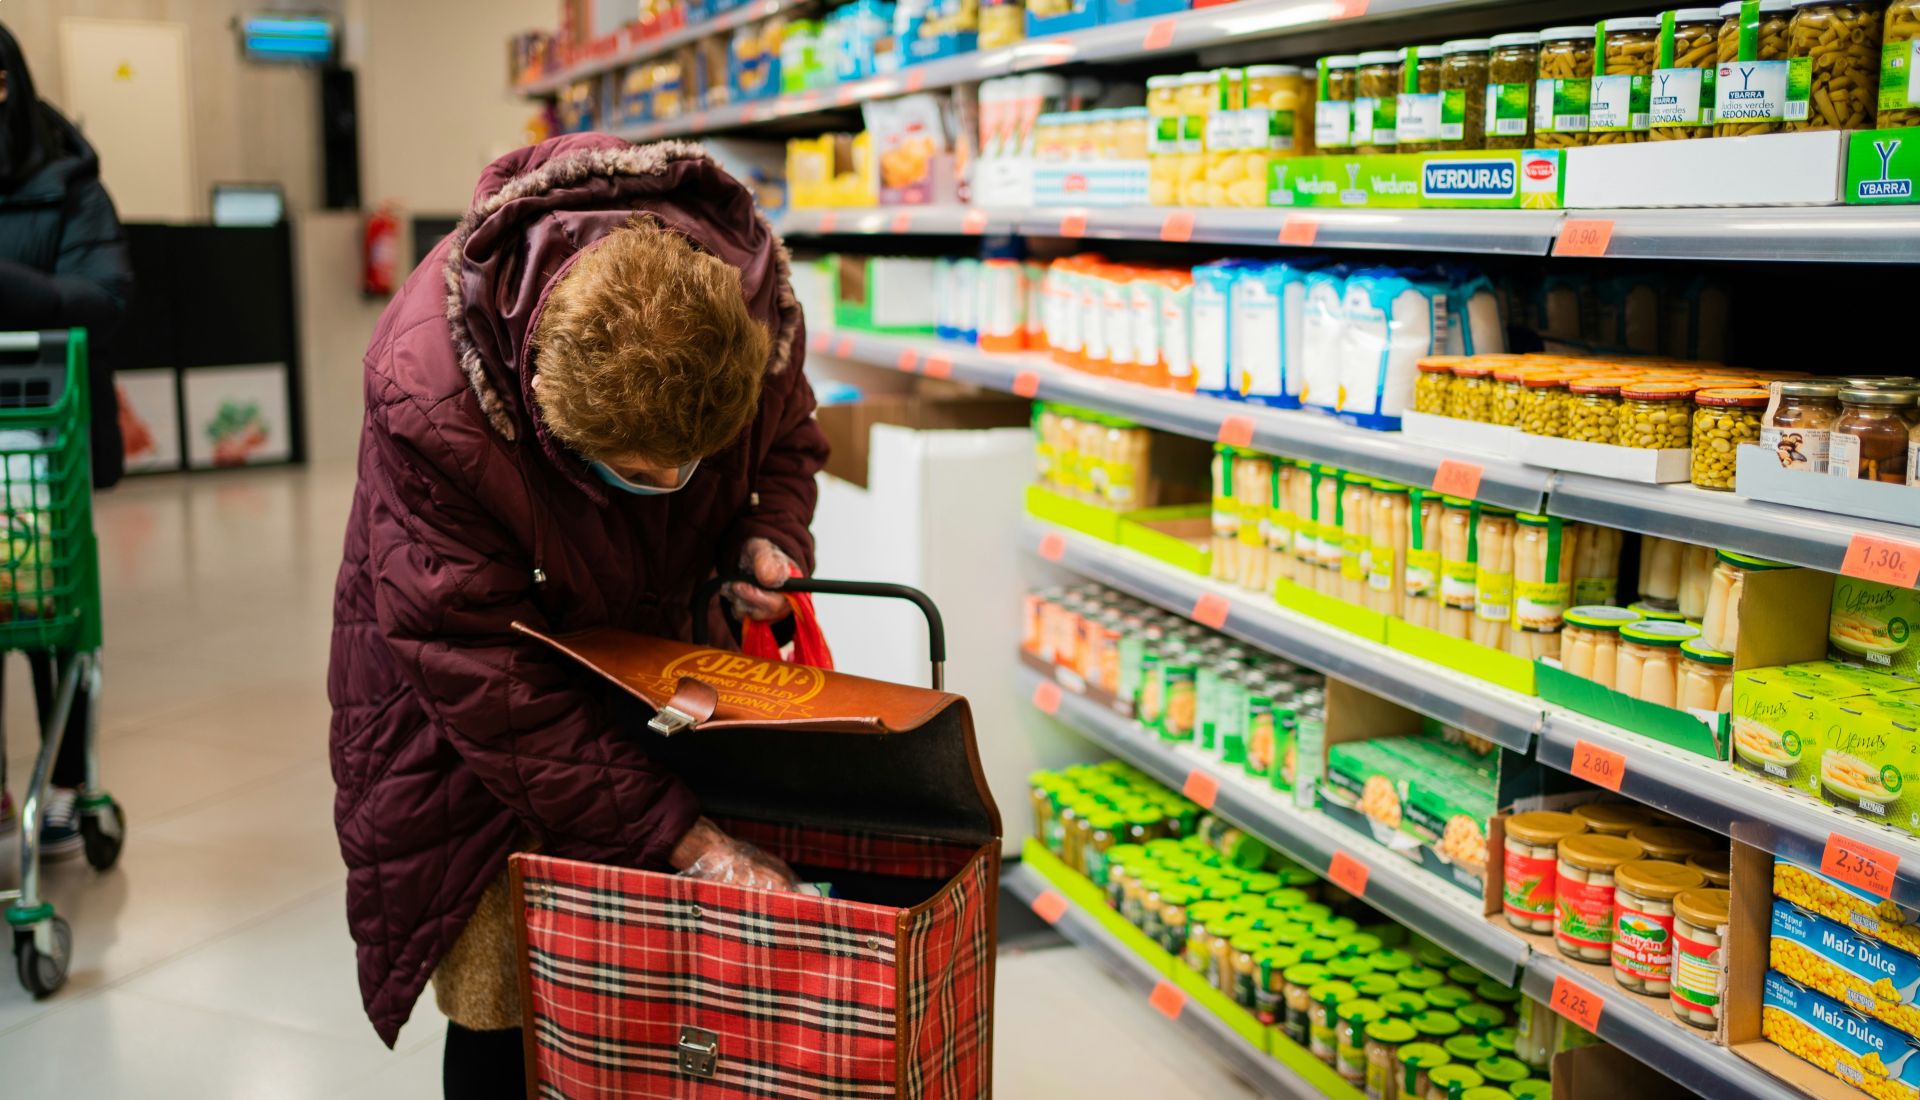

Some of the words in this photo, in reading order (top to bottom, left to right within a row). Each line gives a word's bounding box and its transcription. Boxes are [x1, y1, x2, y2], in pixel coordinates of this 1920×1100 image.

[1744, 99, 1774, 110] verdes
[1295, 173, 1337, 195] Verduras
[1371, 173, 1418, 195] Verduras
[1426, 167, 1513, 191] VERDURAS
[1862, 182, 1907, 195] YBARRA
[1838, 584, 1897, 614] Yemas
[699, 653, 803, 687] JEAN
[740, 682, 798, 699] TROLLEY
[1737, 693, 1790, 718] Yemas
[1808, 712, 1814, 720] 2
[1828, 725, 1889, 755] Yemas
[1911, 745, 1917, 754] 2
[1836, 849, 1880, 881] 2,35€
[1823, 931, 1855, 956] Maíz
[1859, 945, 1896, 976] Dulce
[1813, 1002, 1844, 1030] Maíz
[1848, 1019, 1884, 1051] Dulce
